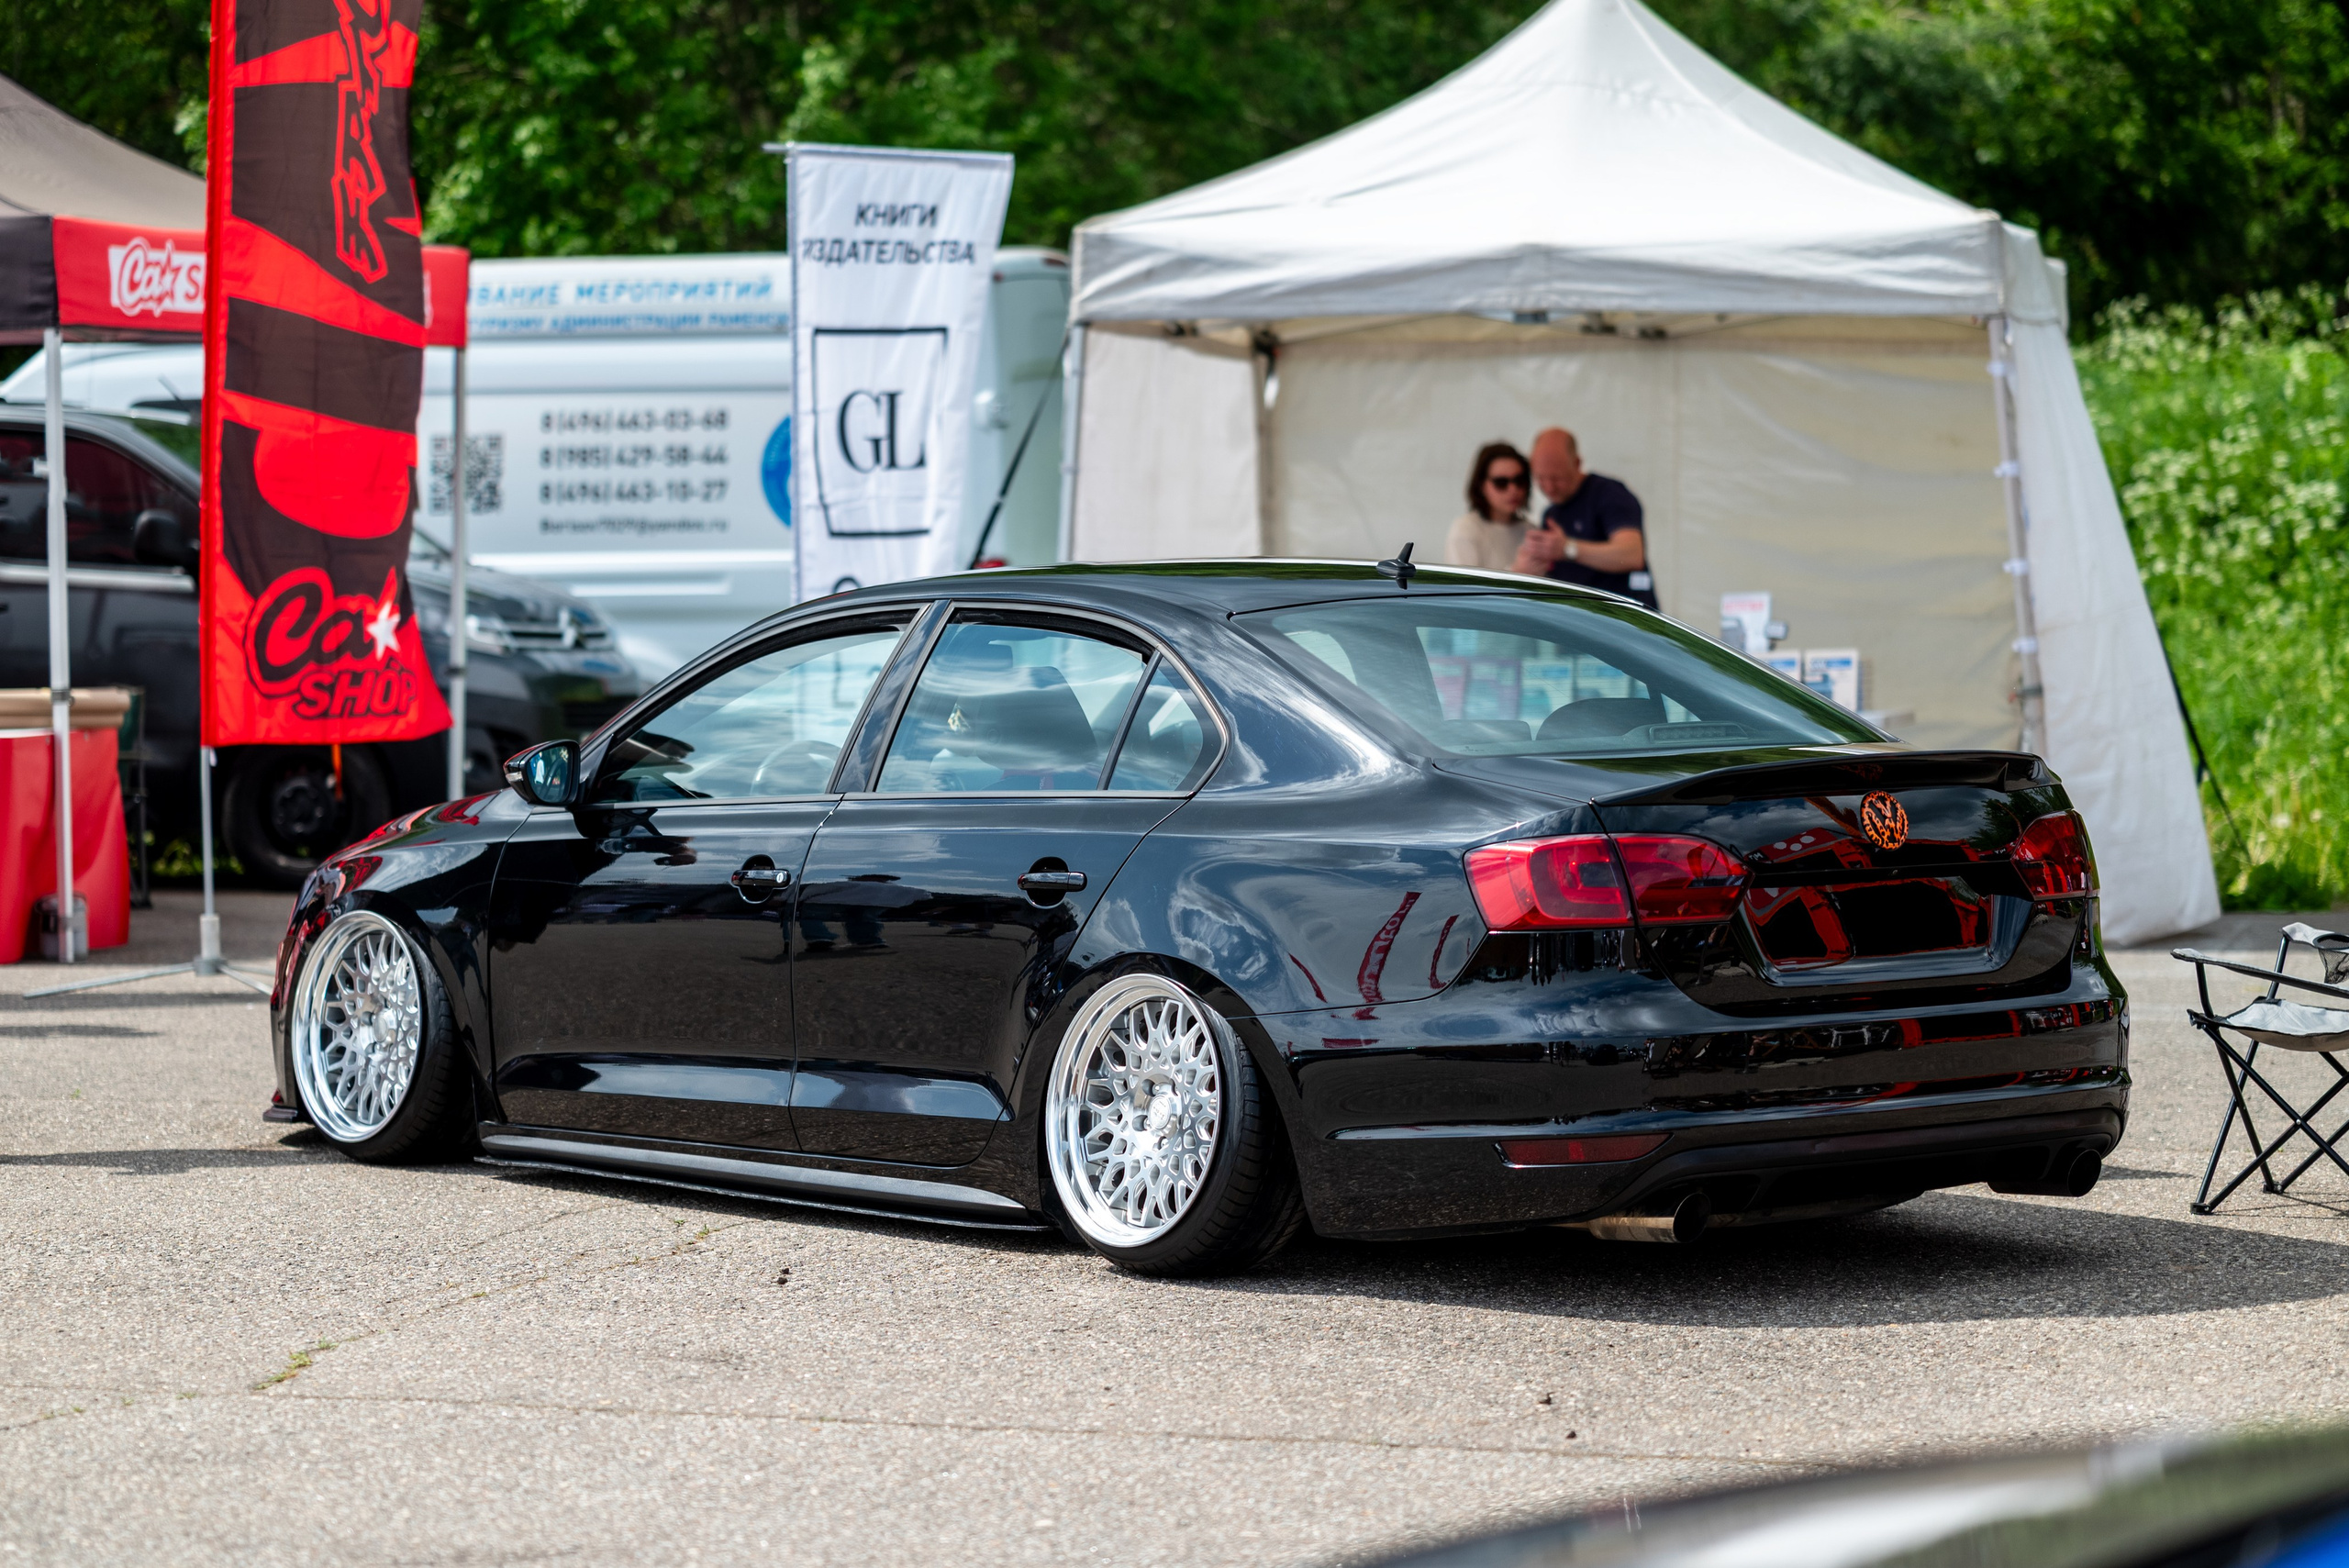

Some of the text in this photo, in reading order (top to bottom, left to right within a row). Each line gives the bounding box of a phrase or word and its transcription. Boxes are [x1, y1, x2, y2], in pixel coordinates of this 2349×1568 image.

[854, 203, 938, 228] КНИГИ
[576, 276, 774, 305] МЕРОПРИЯТИЙ
[838, 389, 926, 473] GL
[293, 667, 416, 718] SHOP
